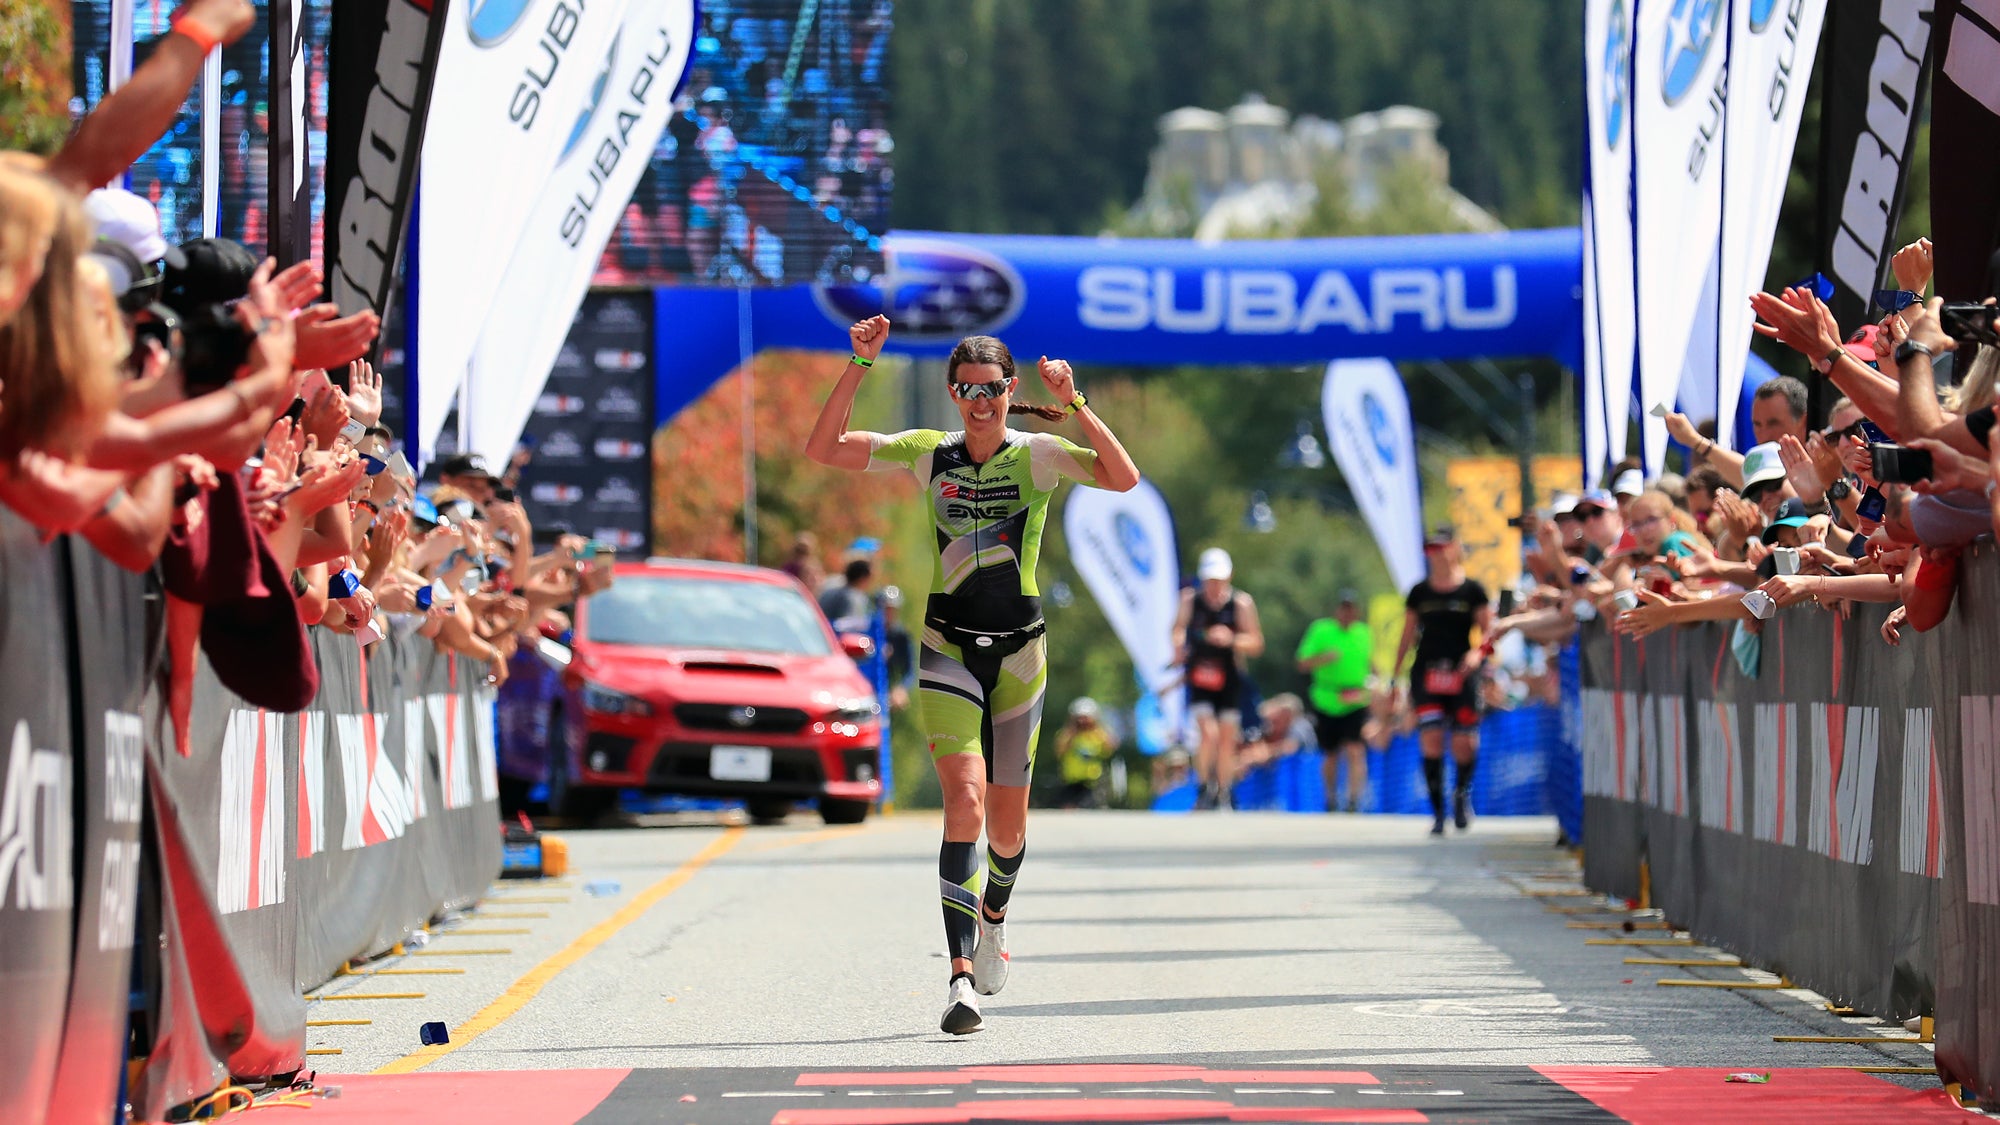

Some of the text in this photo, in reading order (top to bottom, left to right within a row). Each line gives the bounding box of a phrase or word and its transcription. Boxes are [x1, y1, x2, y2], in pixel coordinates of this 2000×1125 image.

[509, 0, 586, 131] SUB
[1077, 265, 1516, 334] SUBARU
[946, 471, 1011, 484] ENDURA
